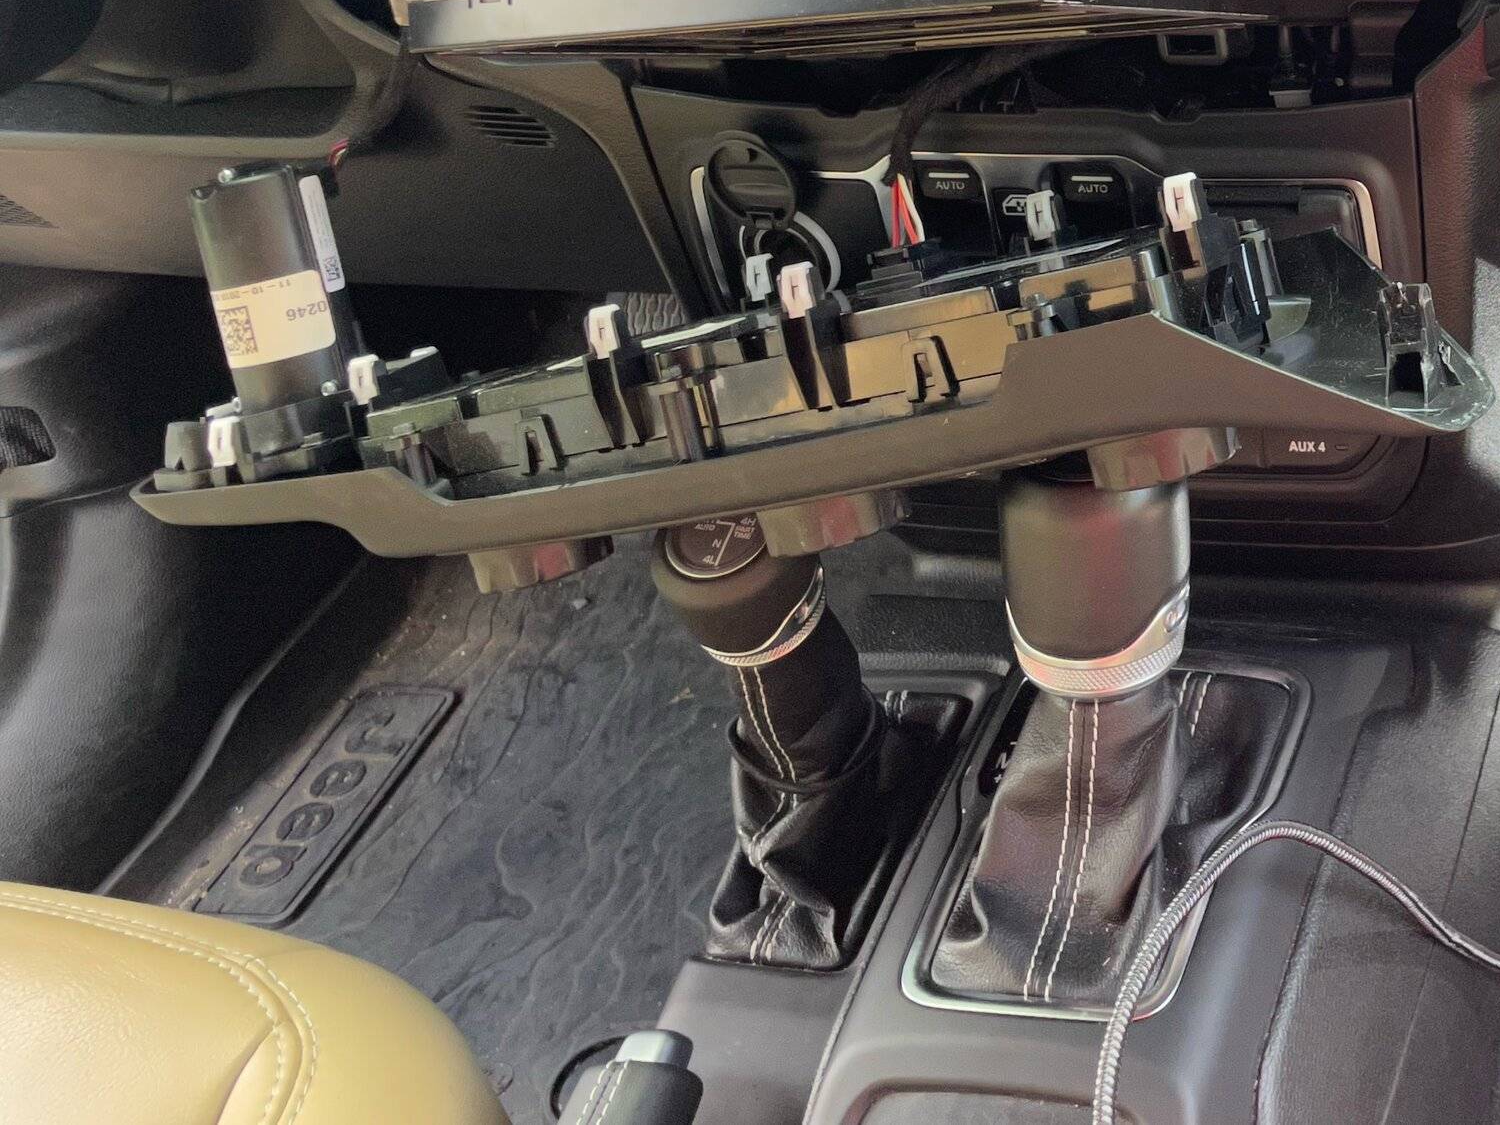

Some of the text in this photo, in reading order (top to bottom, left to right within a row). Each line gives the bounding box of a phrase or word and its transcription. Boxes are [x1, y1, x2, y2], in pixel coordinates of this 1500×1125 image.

[935, 181, 965, 190] AUTO
[1078, 184, 1109, 193] AUTO
[286, 300, 327, 321] 0246
[1289, 440, 1326, 452] AUX 4
[712, 538, 722, 548] N
[702, 555, 716, 565] 4L
[238, 712, 406, 887] Jeep
